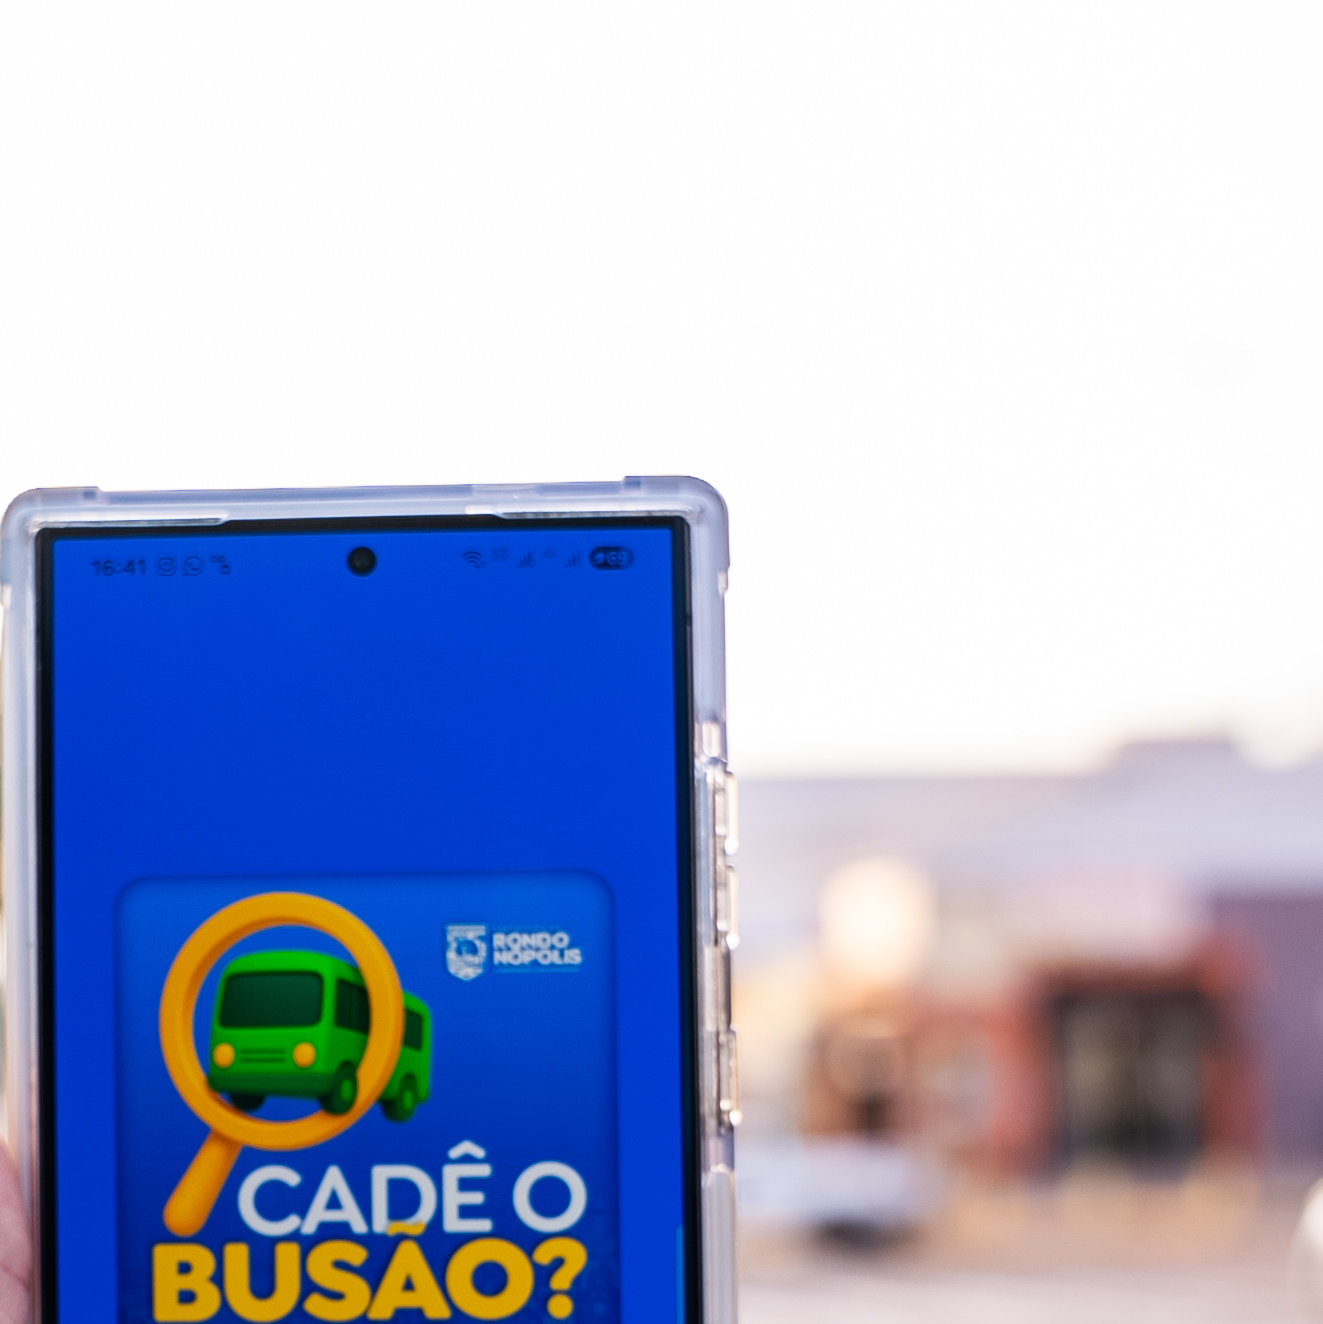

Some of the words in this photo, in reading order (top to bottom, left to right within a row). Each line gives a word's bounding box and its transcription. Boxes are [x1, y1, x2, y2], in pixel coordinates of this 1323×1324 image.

[92, 558, 146, 576] 16:41
[492, 931, 570, 949] RONDO
[238, 1140, 493, 1237] CADÊ
[512, 1160, 588, 1234] O
[152, 1221, 588, 1323] BUSÃO?
